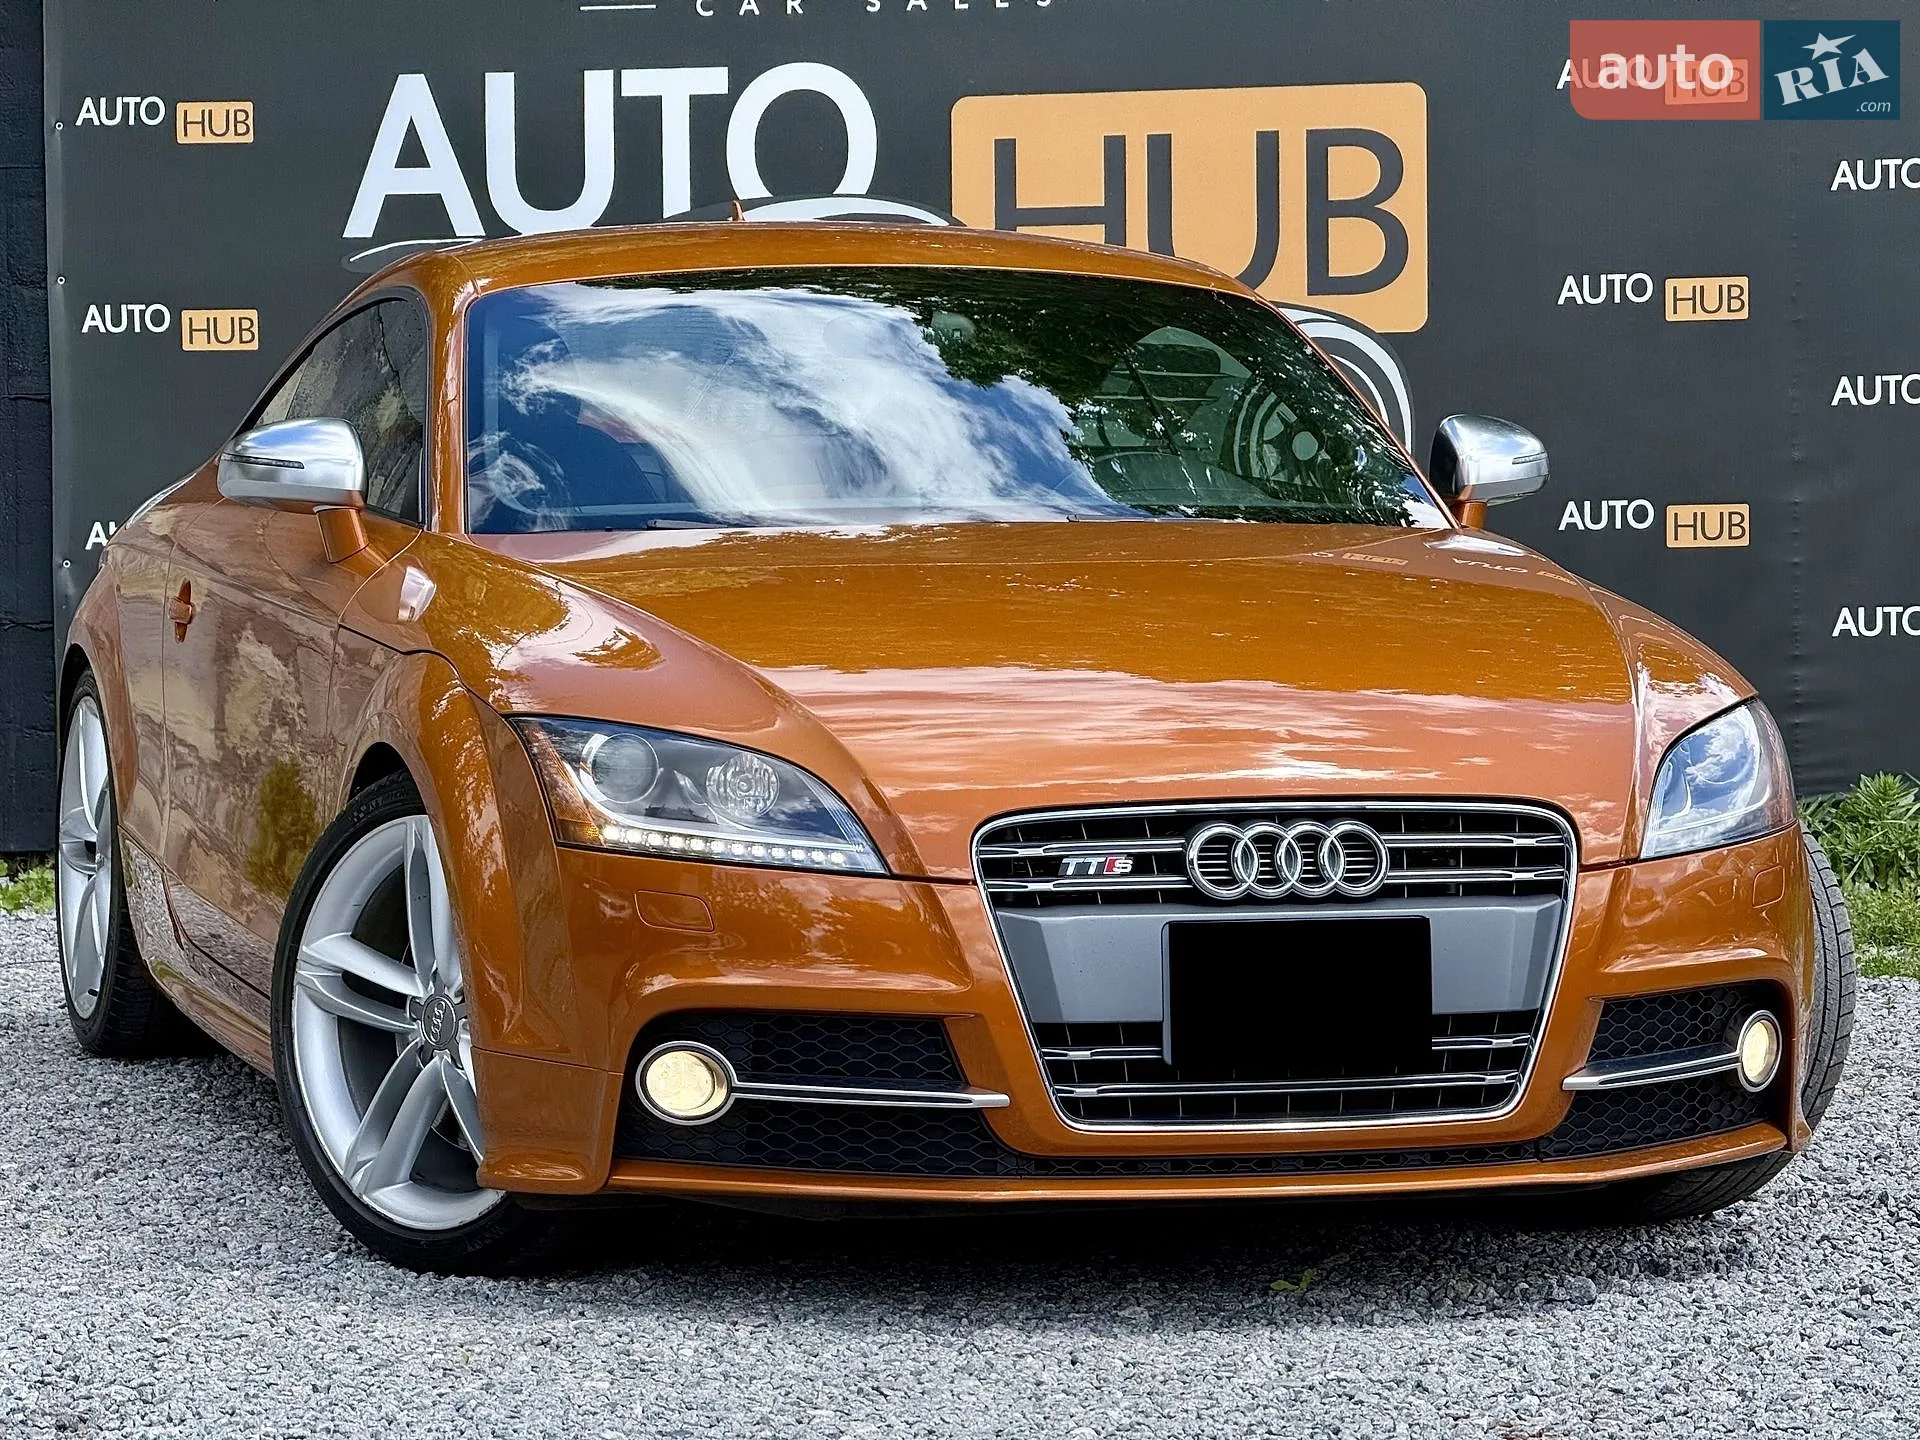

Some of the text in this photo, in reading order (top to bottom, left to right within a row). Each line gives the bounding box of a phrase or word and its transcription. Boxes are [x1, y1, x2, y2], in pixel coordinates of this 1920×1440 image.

[76, 96, 251, 138] AUTO HUB
[342, 62, 1409, 297] AUTO HUB
[1557, 272, 1746, 315] AUTO HUB
[81, 303, 256, 345] AUTO HUB
[1558, 499, 1746, 542] AUTO HUB
[1060, 856, 1134, 875] TTS
